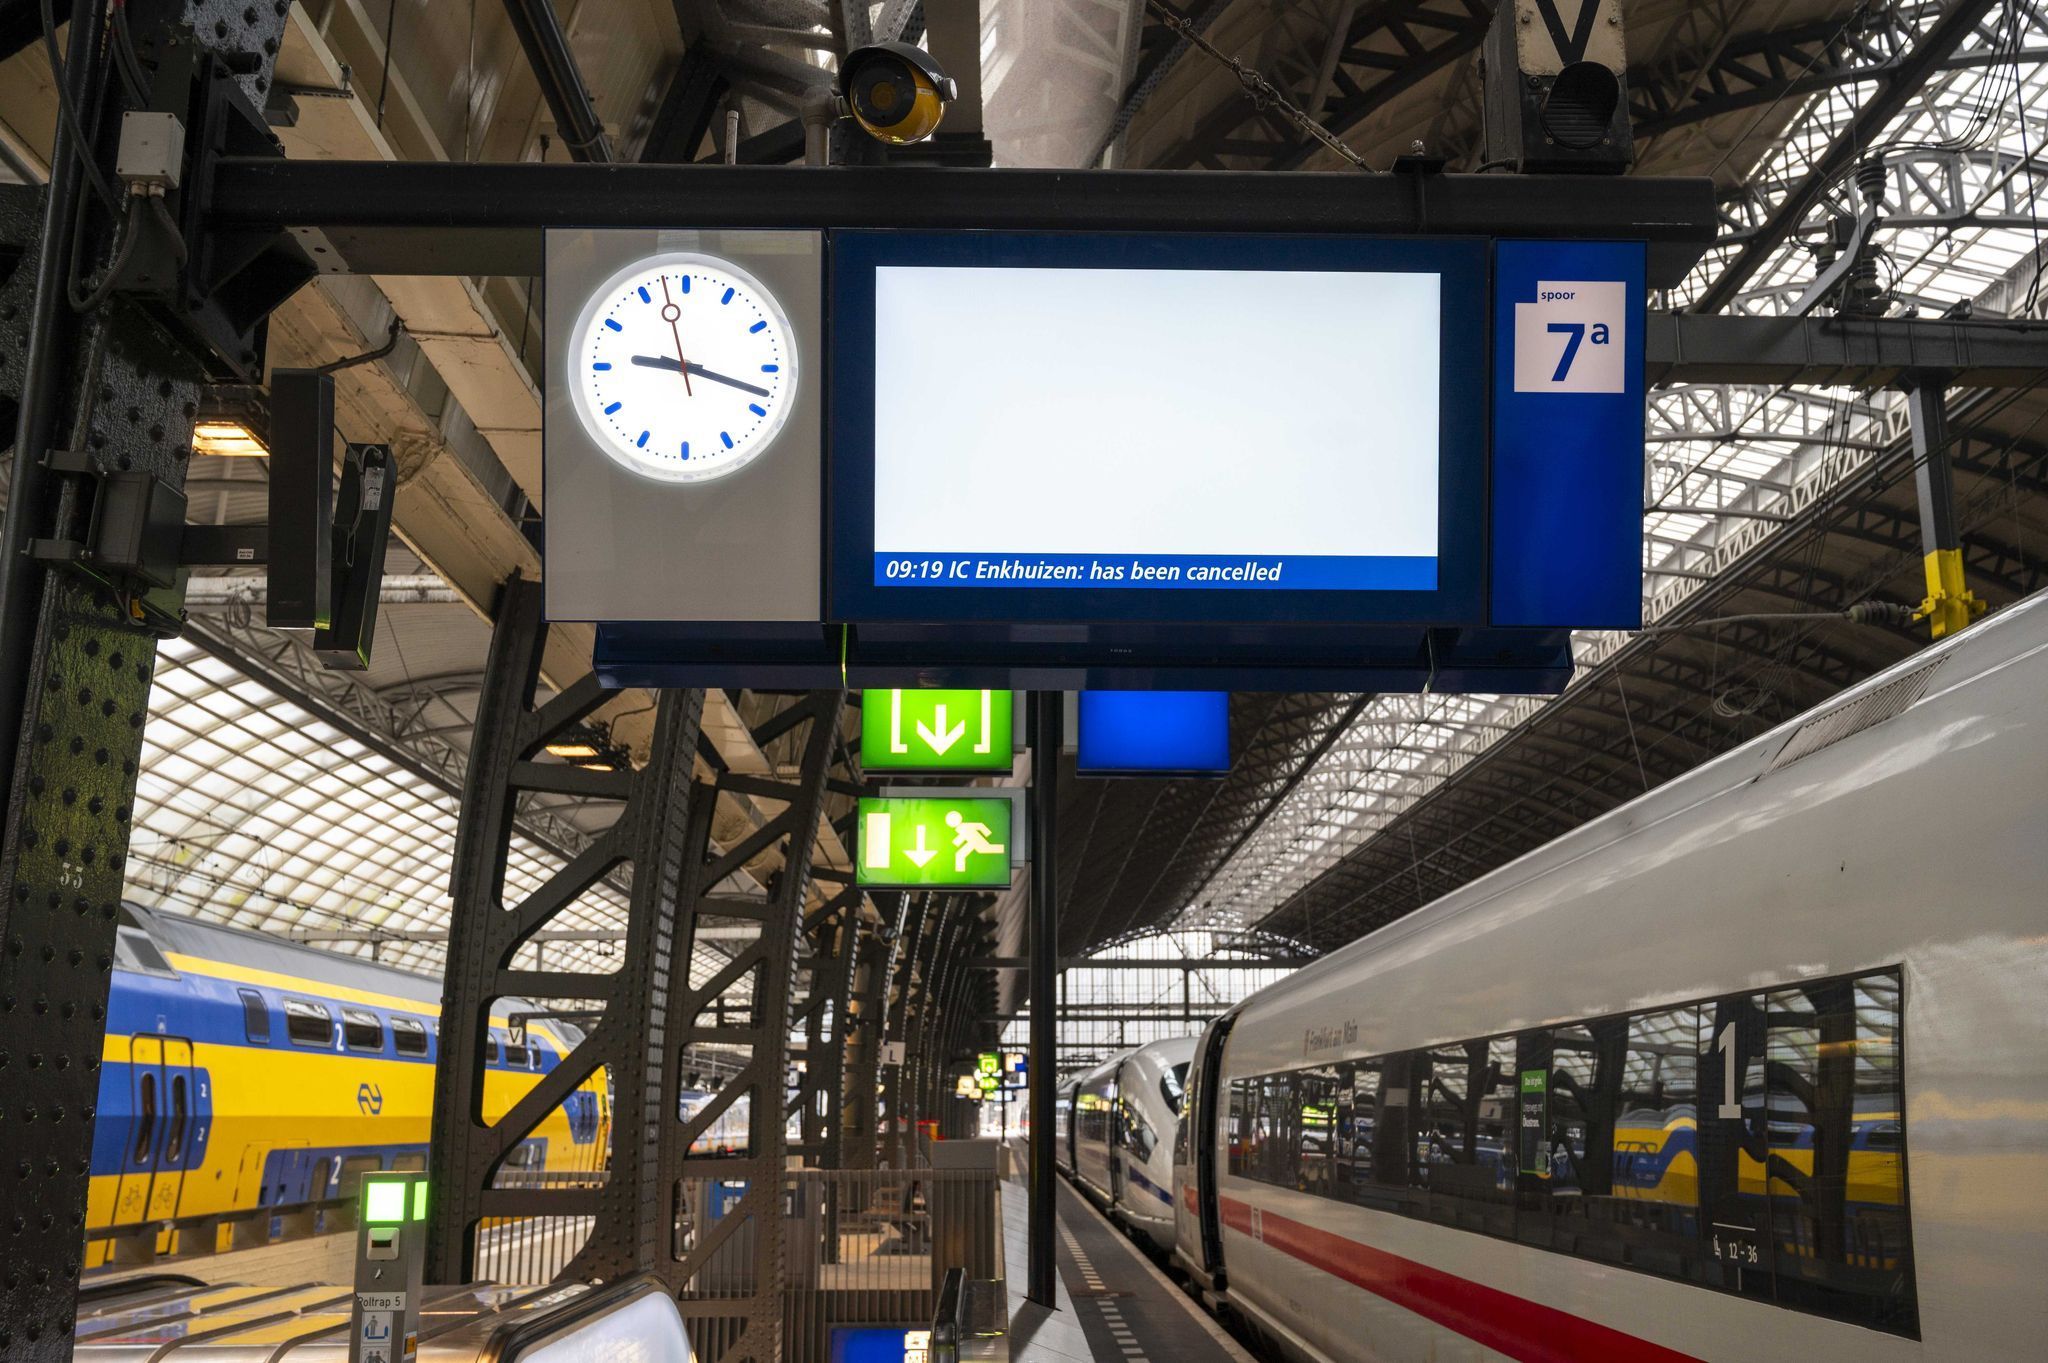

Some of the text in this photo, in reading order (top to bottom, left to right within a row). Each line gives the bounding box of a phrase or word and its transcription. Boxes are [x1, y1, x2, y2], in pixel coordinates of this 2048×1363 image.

[1541, 290, 1576, 301] spoor
[886, 559, 1282, 581] 09:19 IC Enkhuizen: has been cancelled
[335, 1023, 344, 1051] 2
[508, 1028, 520, 1043] V
[889, 1051, 896, 1062] L
[1718, 1021, 1741, 1118] 1
[201, 1083, 207, 1097] 2
[198, 1128, 205, 1141] 2
[330, 1155, 341, 1184] 2
[1729, 1242, 1738, 1259] 12
[1747, 1245, 1758, 1263] 36
[395, 1296, 400, 1306] 5
